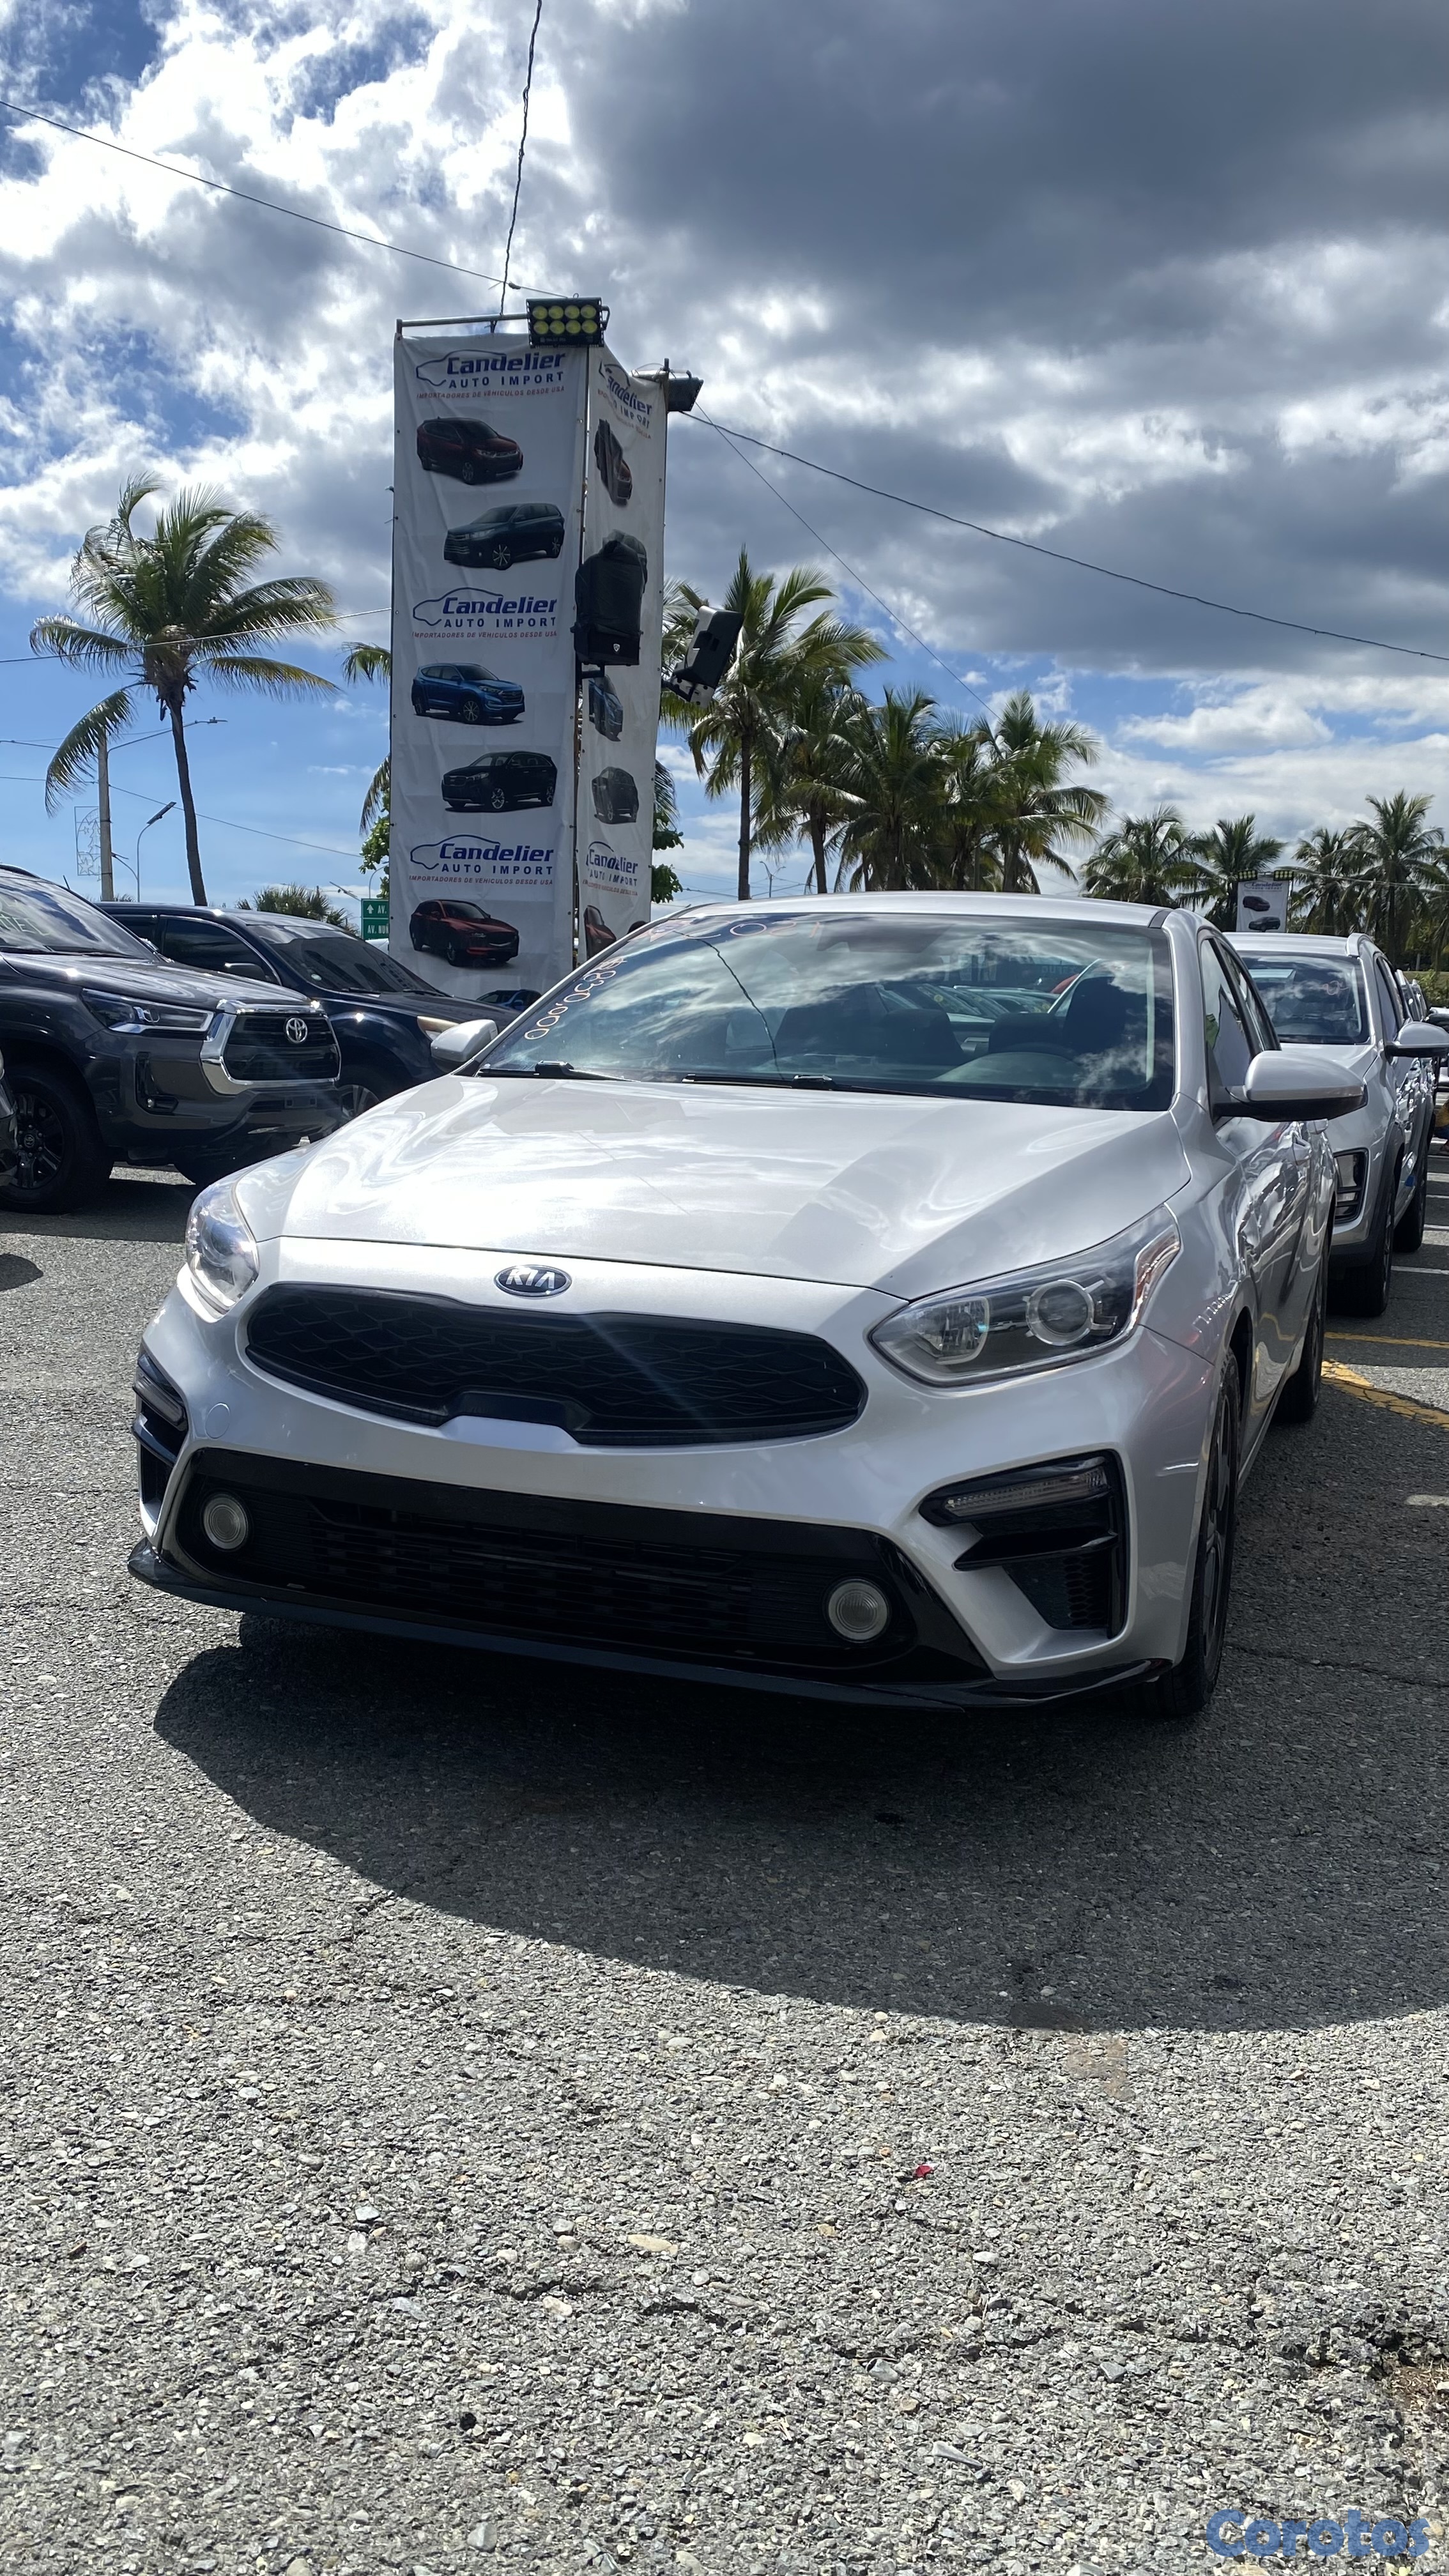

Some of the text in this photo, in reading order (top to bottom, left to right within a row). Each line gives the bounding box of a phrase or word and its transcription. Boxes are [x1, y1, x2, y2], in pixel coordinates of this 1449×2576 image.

[447, 353, 565, 374] Candelier
[448, 371, 564, 388] AUTO IMPORT
[620, 405, 650, 429] IMPORT
[443, 597, 557, 614] Candelier
[444, 617, 556, 628] AUTO IMPORT
[440, 843, 554, 861] Candelier
[441, 863, 553, 875] AUTO IMPORT
[378, 905, 387, 914] AV.
[367, 925, 377, 933] AV.
[505, 1268, 555, 1289] KIA
